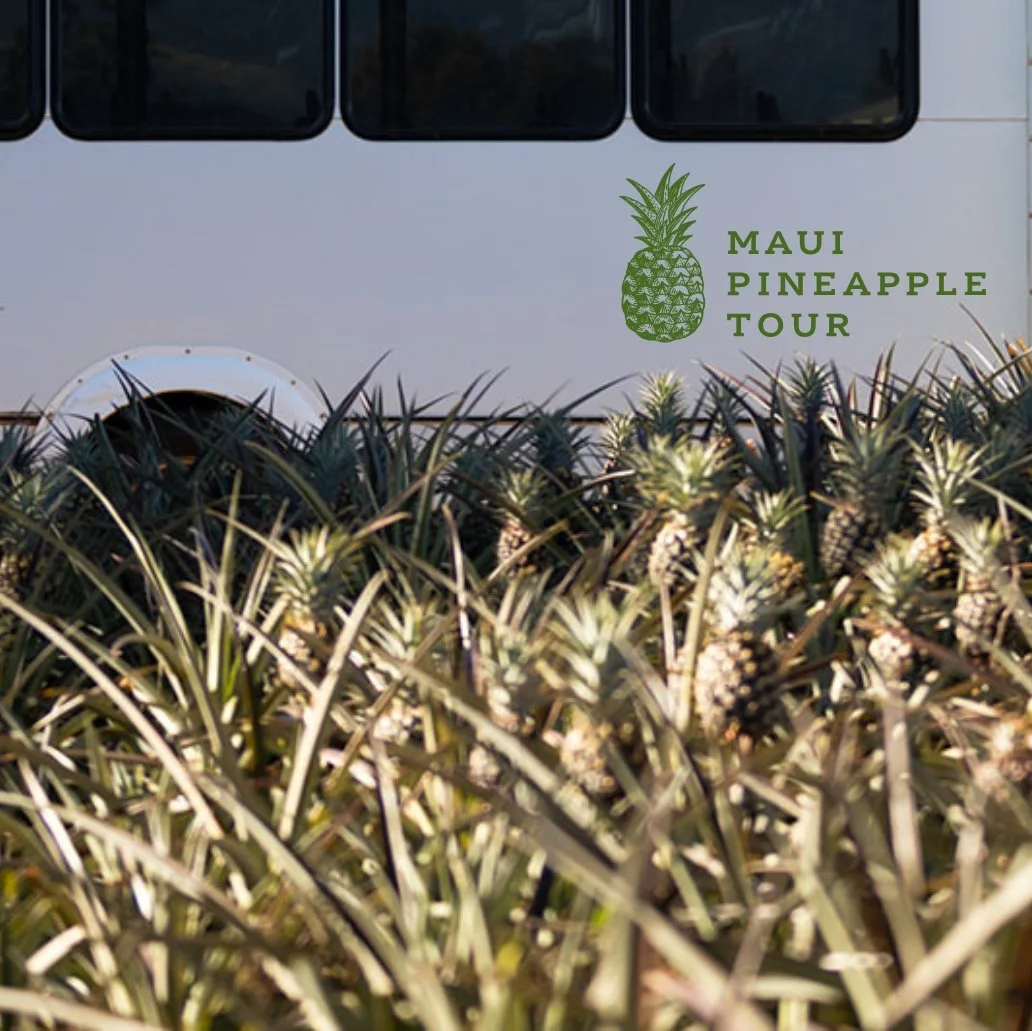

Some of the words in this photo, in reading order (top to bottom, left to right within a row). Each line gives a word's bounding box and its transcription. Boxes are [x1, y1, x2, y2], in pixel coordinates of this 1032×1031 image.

[728, 231, 843, 255] MAUI
[728, 271, 988, 296] PINEAPPLE
[727, 312, 849, 338] TOUR
